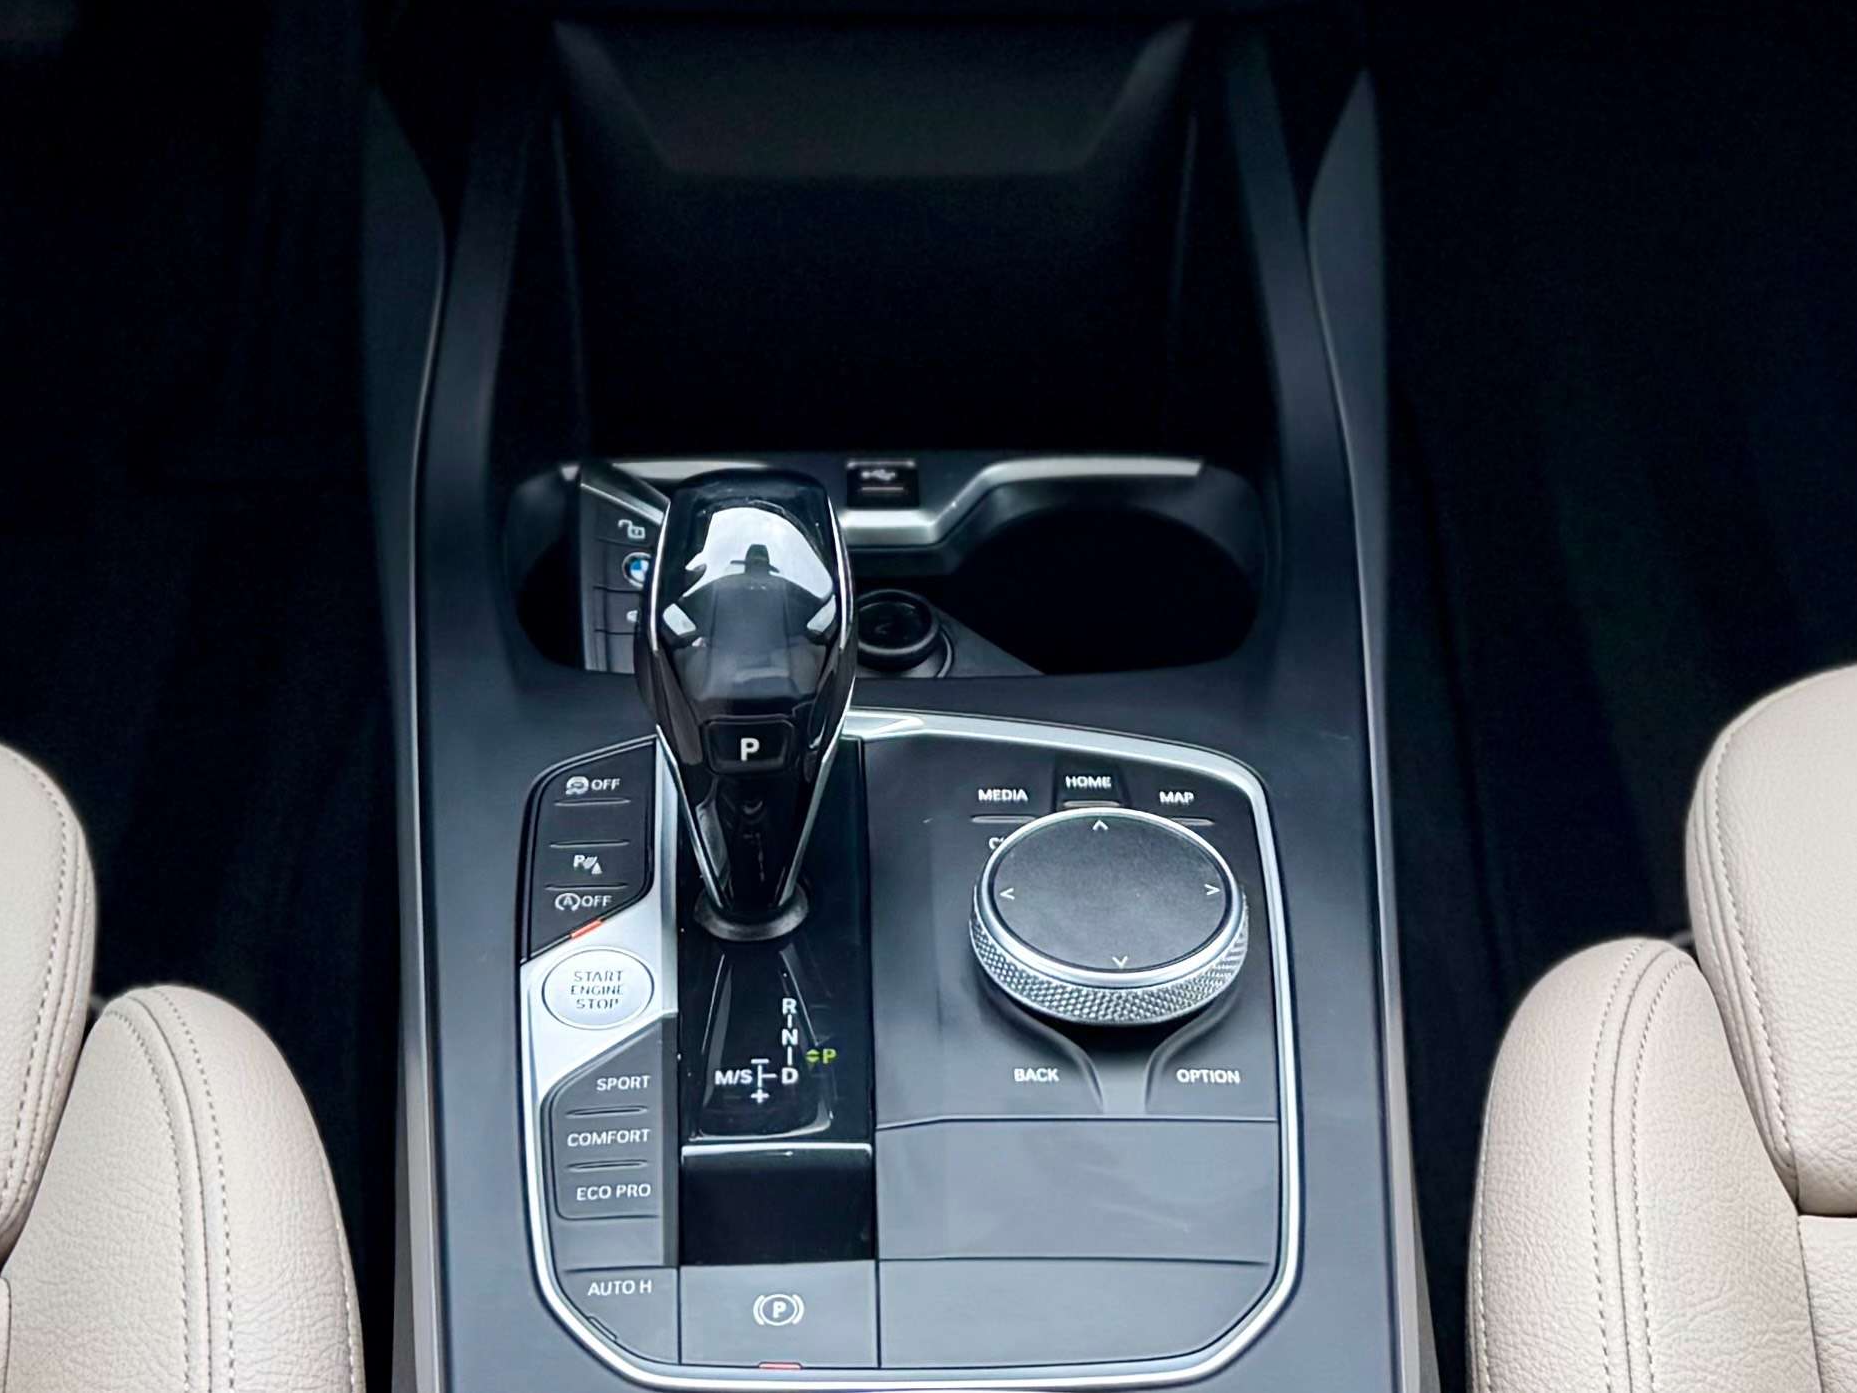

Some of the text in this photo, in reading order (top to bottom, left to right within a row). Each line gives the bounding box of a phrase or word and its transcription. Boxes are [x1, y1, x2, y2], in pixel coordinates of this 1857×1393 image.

[742, 738, 760, 761] P
[591, 777, 621, 792] OFF
[1064, 775, 1112, 790] HOME
[977, 788, 1028, 803] MEDIA
[1159, 790, 1194, 805] MAP
[581, 895, 612, 909] OFF
[573, 969, 624, 983] START
[576, 997, 619, 1010] STOP
[782, 998, 797, 1014] R
[782, 1029, 798, 1045] N
[822, 1048, 837, 1064] P
[596, 1075, 650, 1091] SPORT
[714, 1068, 753, 1085] M/S
[782, 1069, 799, 1084] D
[1014, 1067, 1059, 1083] BACK
[1176, 1068, 1241, 1084] OPTION
[567, 1129, 650, 1148] COMFORT
[576, 1182, 651, 1201] ECO PRO
[588, 1279, 653, 1296] AUTO H
